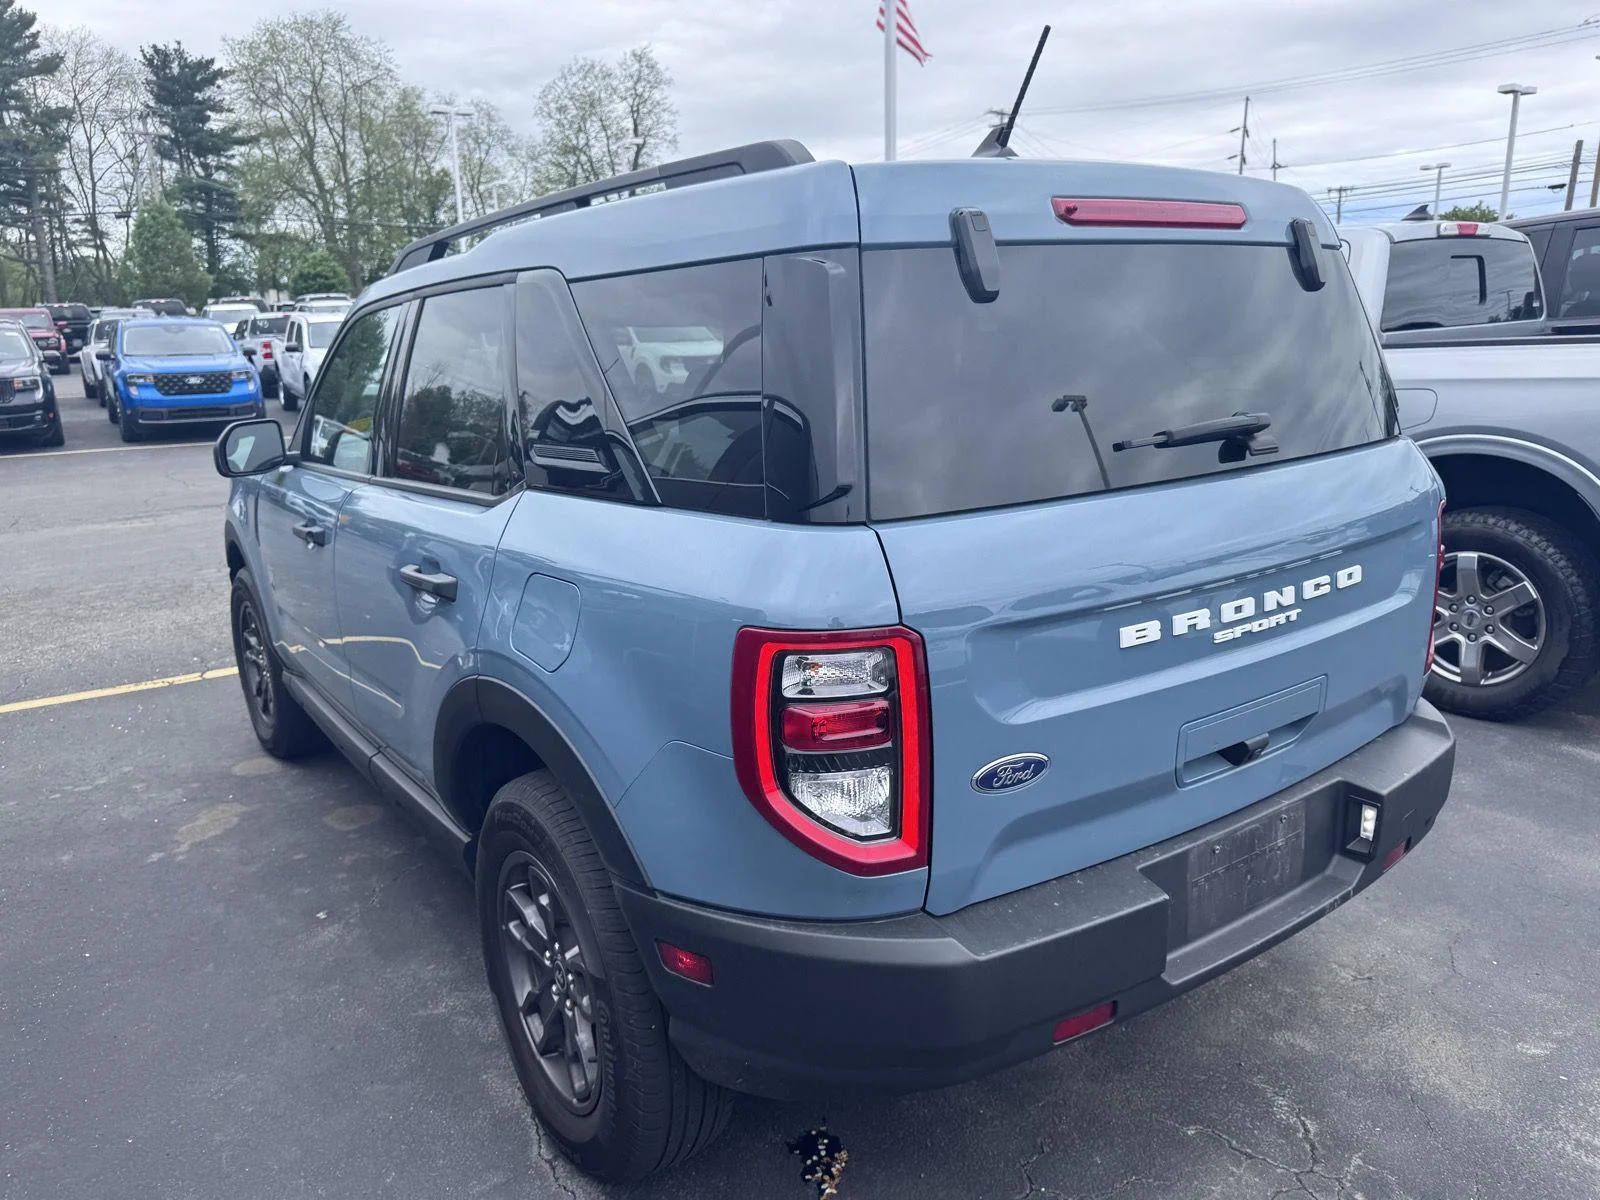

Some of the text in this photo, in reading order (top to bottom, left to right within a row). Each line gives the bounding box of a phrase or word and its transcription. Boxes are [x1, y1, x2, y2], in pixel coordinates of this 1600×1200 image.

[1119, 564, 1362, 649] BRONCO
[1213, 608, 1302, 644] SPORT
[992, 761, 1035, 788] Ford
